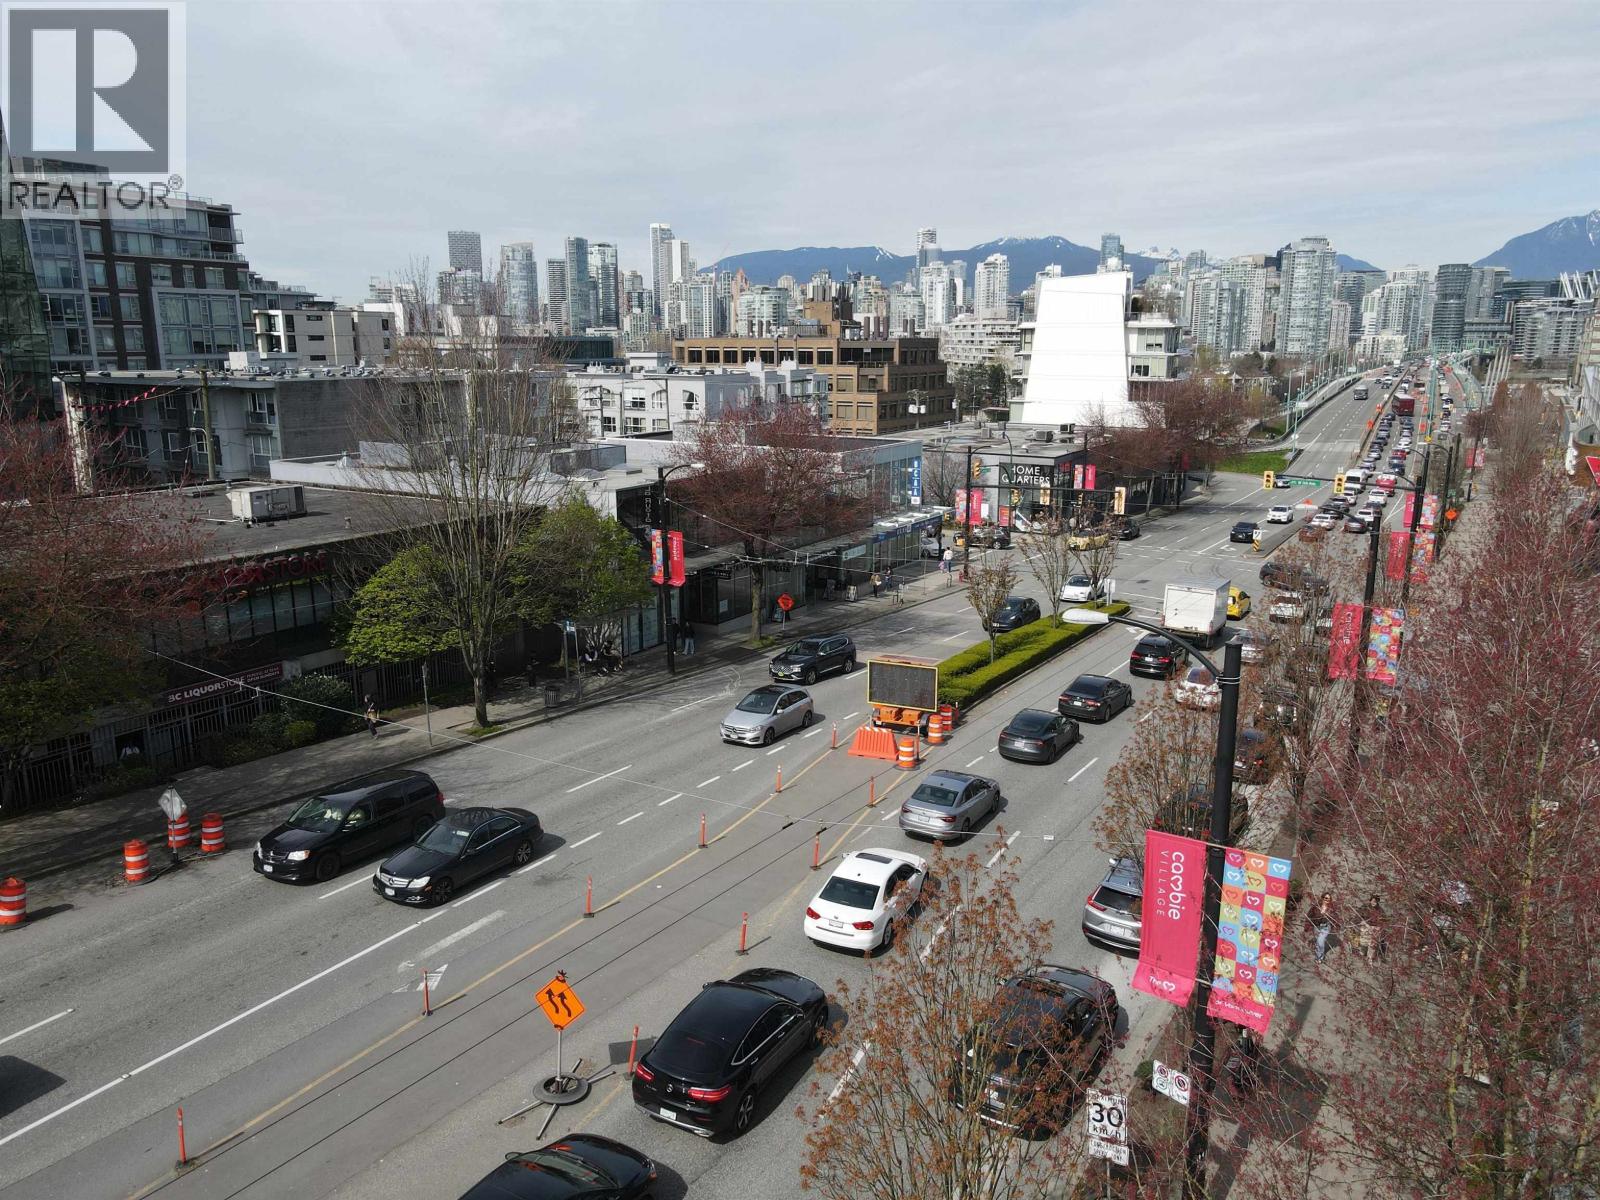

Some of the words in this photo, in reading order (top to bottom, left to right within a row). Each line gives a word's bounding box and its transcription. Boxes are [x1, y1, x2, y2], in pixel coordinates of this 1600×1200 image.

[1001, 474, 1050, 485] QUARTERS
[1010, 465, 1041, 476] HOME
[1156, 849, 1170, 917] VILLAGE
[1168, 851, 1187, 920] cambie
[1091, 1102, 1124, 1128] 30
[1092, 1124, 1121, 1138] km/h
